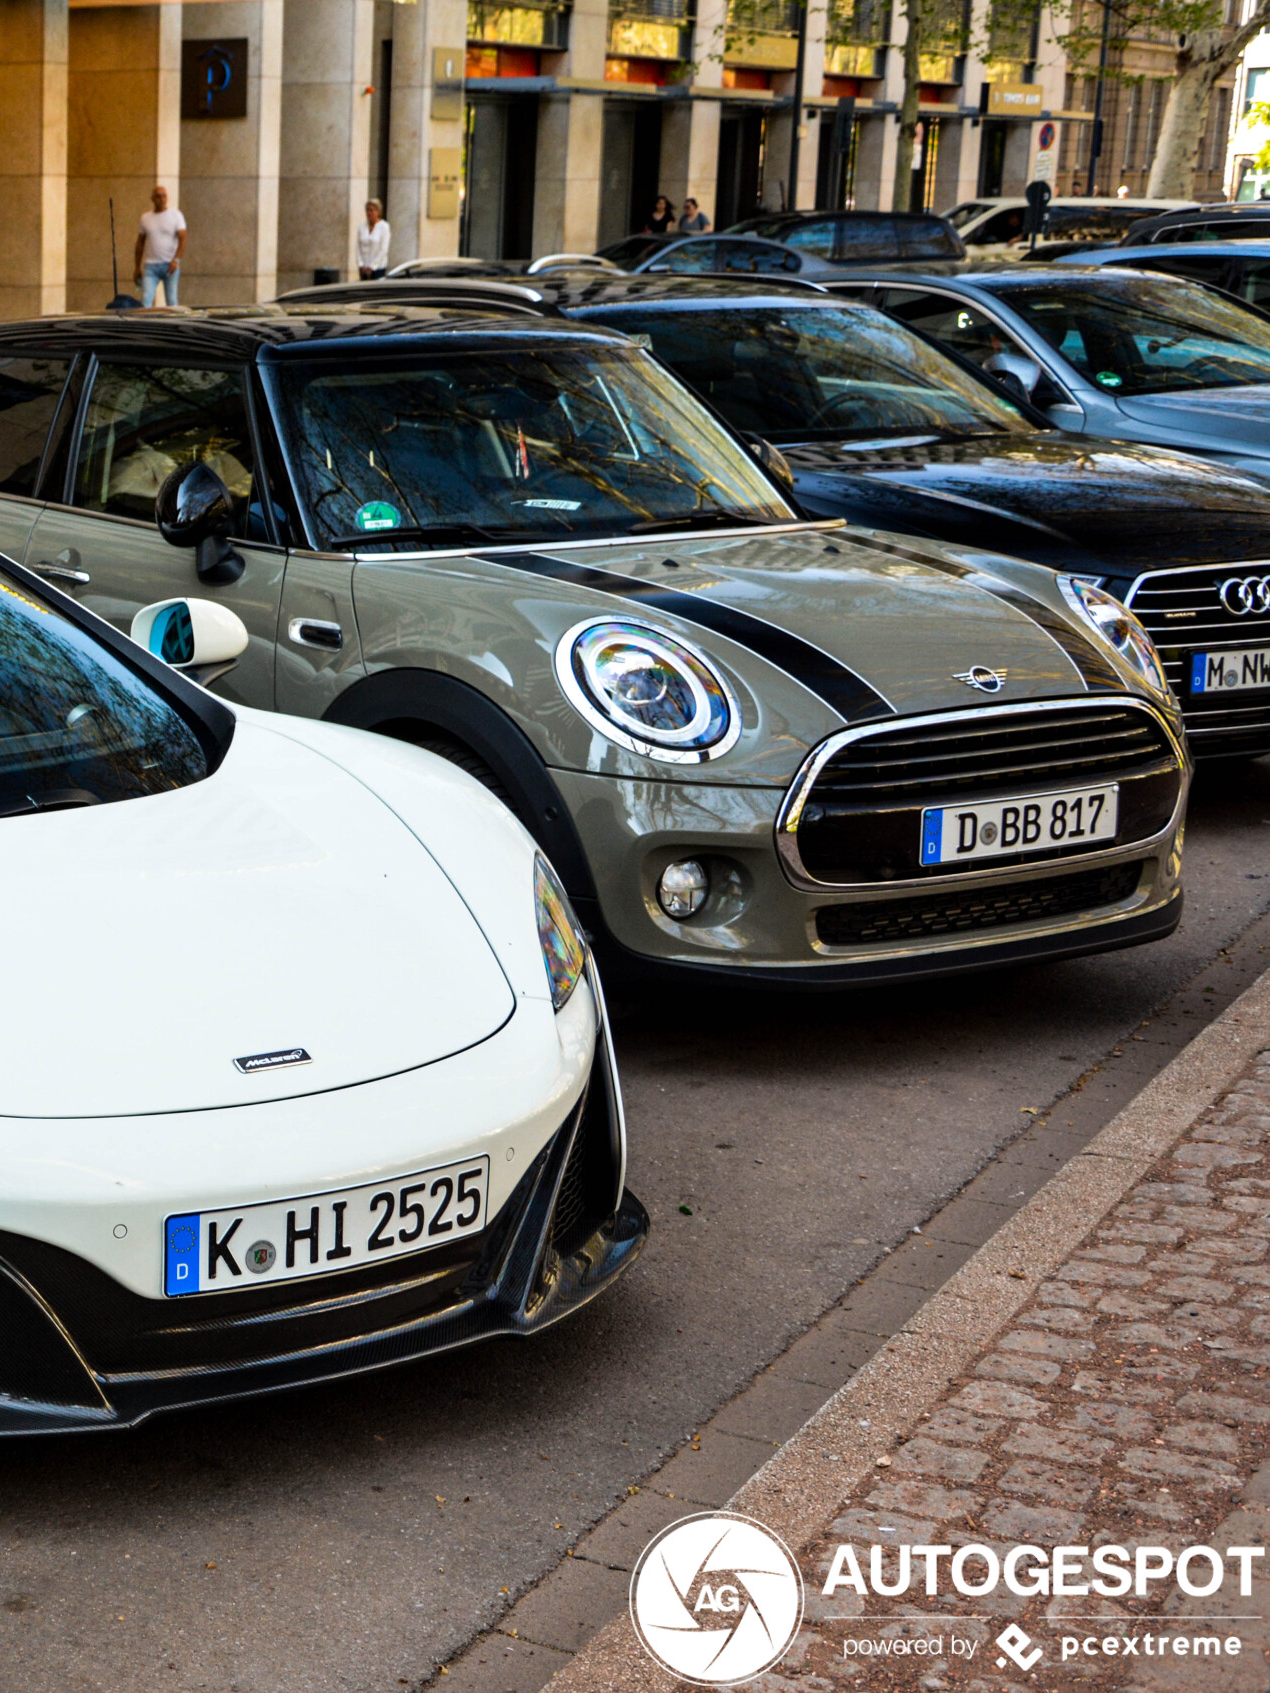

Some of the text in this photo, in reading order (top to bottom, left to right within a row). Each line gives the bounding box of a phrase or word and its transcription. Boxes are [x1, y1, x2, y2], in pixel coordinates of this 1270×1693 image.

[1207, 656, 1225, 687] M
[957, 794, 1105, 853] D BB 817
[928, 842, 936, 854] D
[246, 1054, 300, 1068] McLaren
[208, 1168, 483, 1280] K HI 2525
[176, 1263, 189, 1280] D
